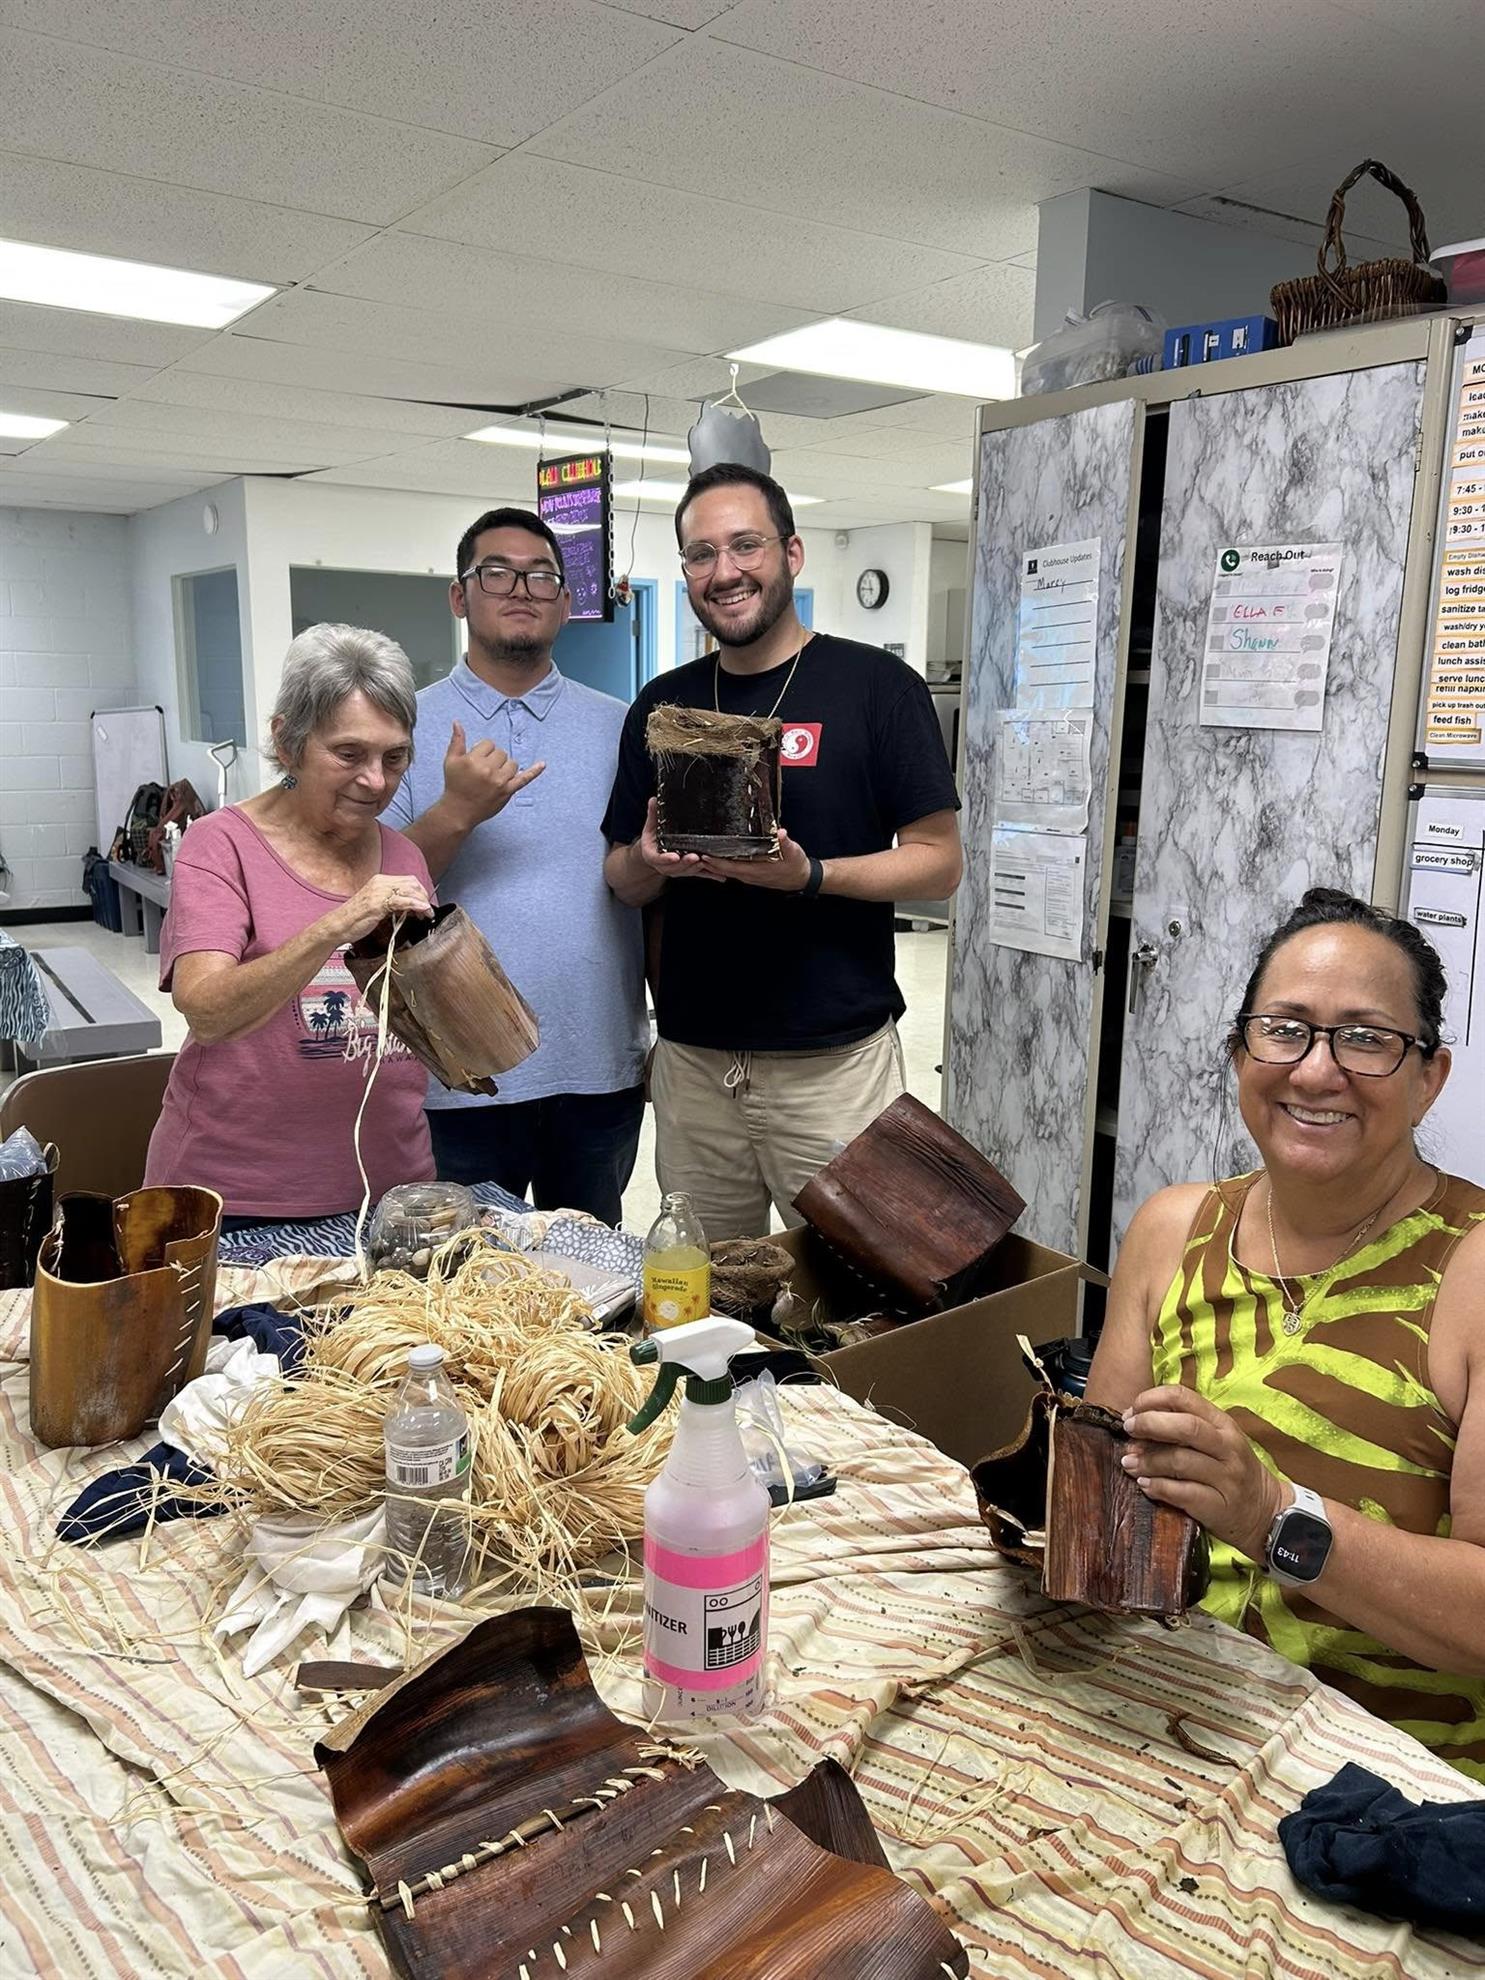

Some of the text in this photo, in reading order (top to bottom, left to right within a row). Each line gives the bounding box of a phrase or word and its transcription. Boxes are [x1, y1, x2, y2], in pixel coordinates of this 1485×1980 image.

[1459, 449, 1475, 461] put
[1456, 484, 1477, 495] 7:45
[1453, 505, 1473, 516] 9:30
[1042, 553, 1093, 568] Clubhouse Updates
[1250, 549, 1305, 561] Reach Out
[1447, 566, 1471, 576] wash
[1445, 585, 1460, 596] log
[1233, 604, 1267, 619] ELLA
[1441, 604, 1476, 613] sanitize
[1441, 641, 1466, 650] clean
[1437, 656, 1463, 665] lunch
[1438, 675, 1463, 683] serve
[1432, 701, 1446, 709] pick
[1433, 714, 1472, 725] feed fish
[1428, 824, 1459, 837] Monday
[1415, 855, 1473, 867] grocery shop
[1416, 911, 1462, 923] water plants
[650, 1276, 689, 1287] Hawaiian
[1277, 1546, 1300, 1564] 11:43
